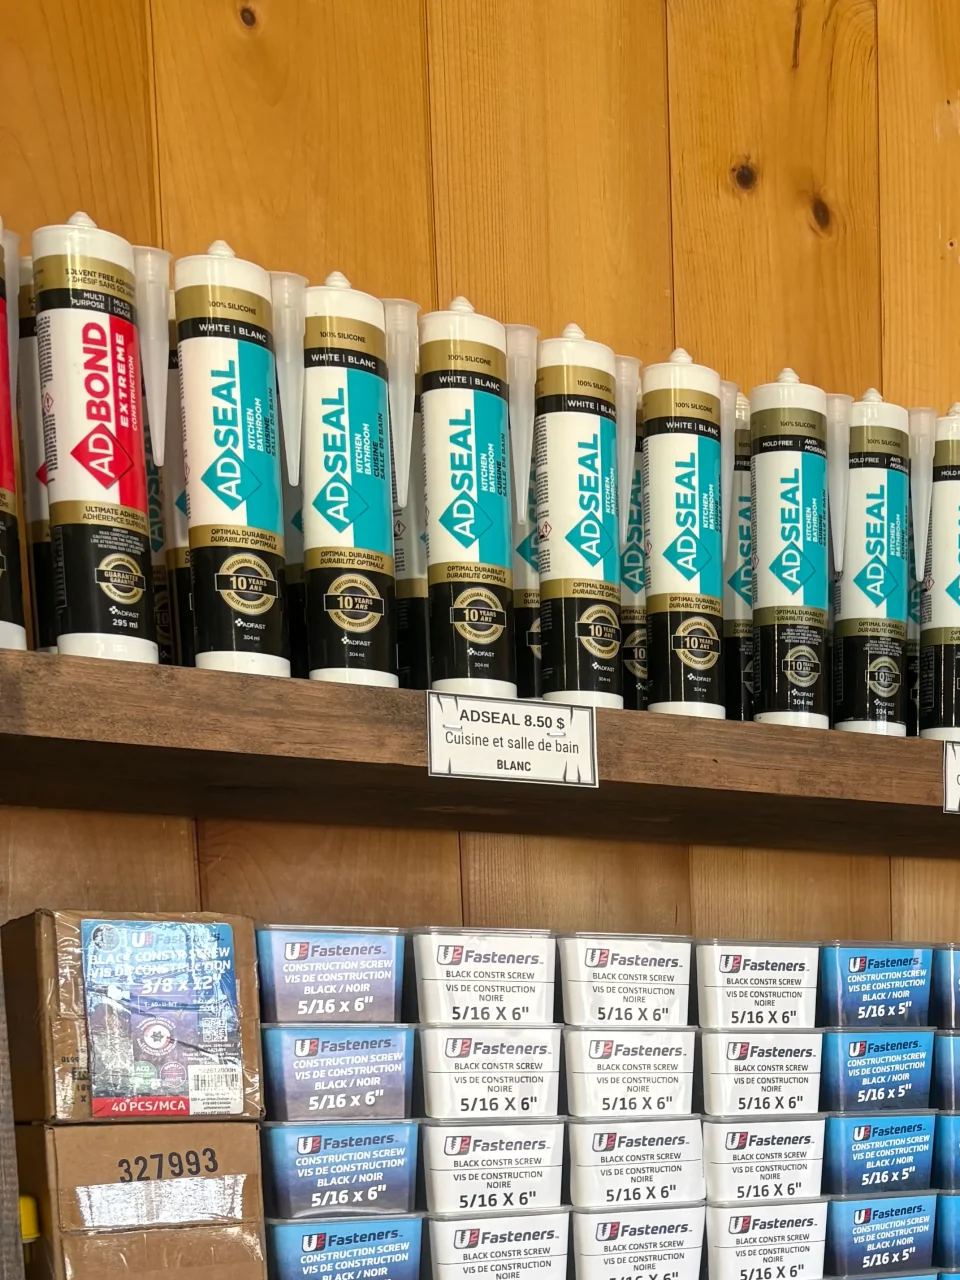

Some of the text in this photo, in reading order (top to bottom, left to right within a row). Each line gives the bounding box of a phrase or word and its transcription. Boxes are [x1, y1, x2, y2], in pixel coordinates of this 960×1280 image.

[199, 323, 266, 342] WHITE BLANC
[81, 321, 115, 483] ADBOND
[116, 333, 129, 427] EXTREME
[128, 355, 138, 432] CONSTRUCTION
[213, 359, 244, 500] ADSEAL
[247, 408, 255, 449] KITCHEN
[256, 398, 264, 451] BATHROOM
[449, 408, 474, 539] ADSEAL
[780, 468, 800, 585] ADSEAL
[445, 731, 579, 754] Cuisine et salle de bain
[459, 709, 565, 729] ADSEAL 8.50 $
[497, 760, 531, 771] BLANC
[130, 1100, 186, 1112] PCS/MCA
[118, 1148, 219, 1182] 327993
